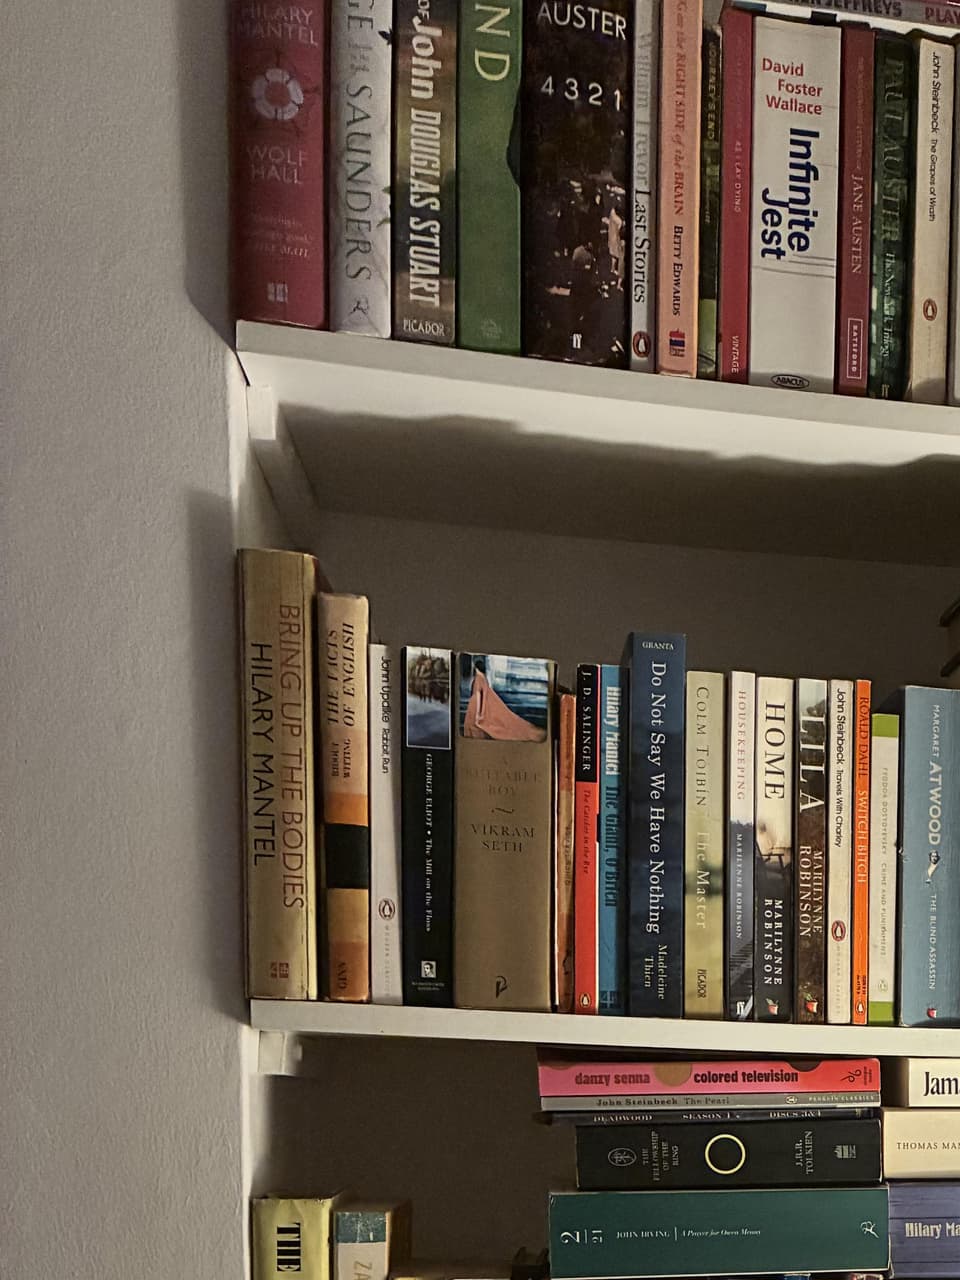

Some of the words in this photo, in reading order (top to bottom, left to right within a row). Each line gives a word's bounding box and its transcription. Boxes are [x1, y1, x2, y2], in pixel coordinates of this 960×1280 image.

[538, 3, 627, 40] AUSTER
[411, 14, 443, 100] John
[762, 57, 804, 77] David
[765, 94, 823, 116] Wallace
[777, 77, 823, 98] Foster
[344, 83, 376, 281] SAUNDERS
[408, 107, 443, 210] DOUGLAS
[788, 127, 820, 253] Infinite
[761, 188, 786, 260] Jest
[408, 215, 442, 308] STUART
[402, 318, 446, 337] PICADOR
[641, 641, 675, 652] GRANTA
[250, 641, 273, 747] HILARY
[650, 660, 668, 687] Do
[650, 692, 667, 725] Not
[646, 727, 667, 768] Say
[764, 700, 786, 801] HOME
[251, 752, 276, 867] MANTEL
[649, 772, 666, 807] We
[648, 807, 666, 858] Have
[645, 861, 666, 934] Nothing
[693, 1070, 738, 1084] colored
[741, 1069, 798, 1083] television
[275, 1222, 303, 1273] THE
